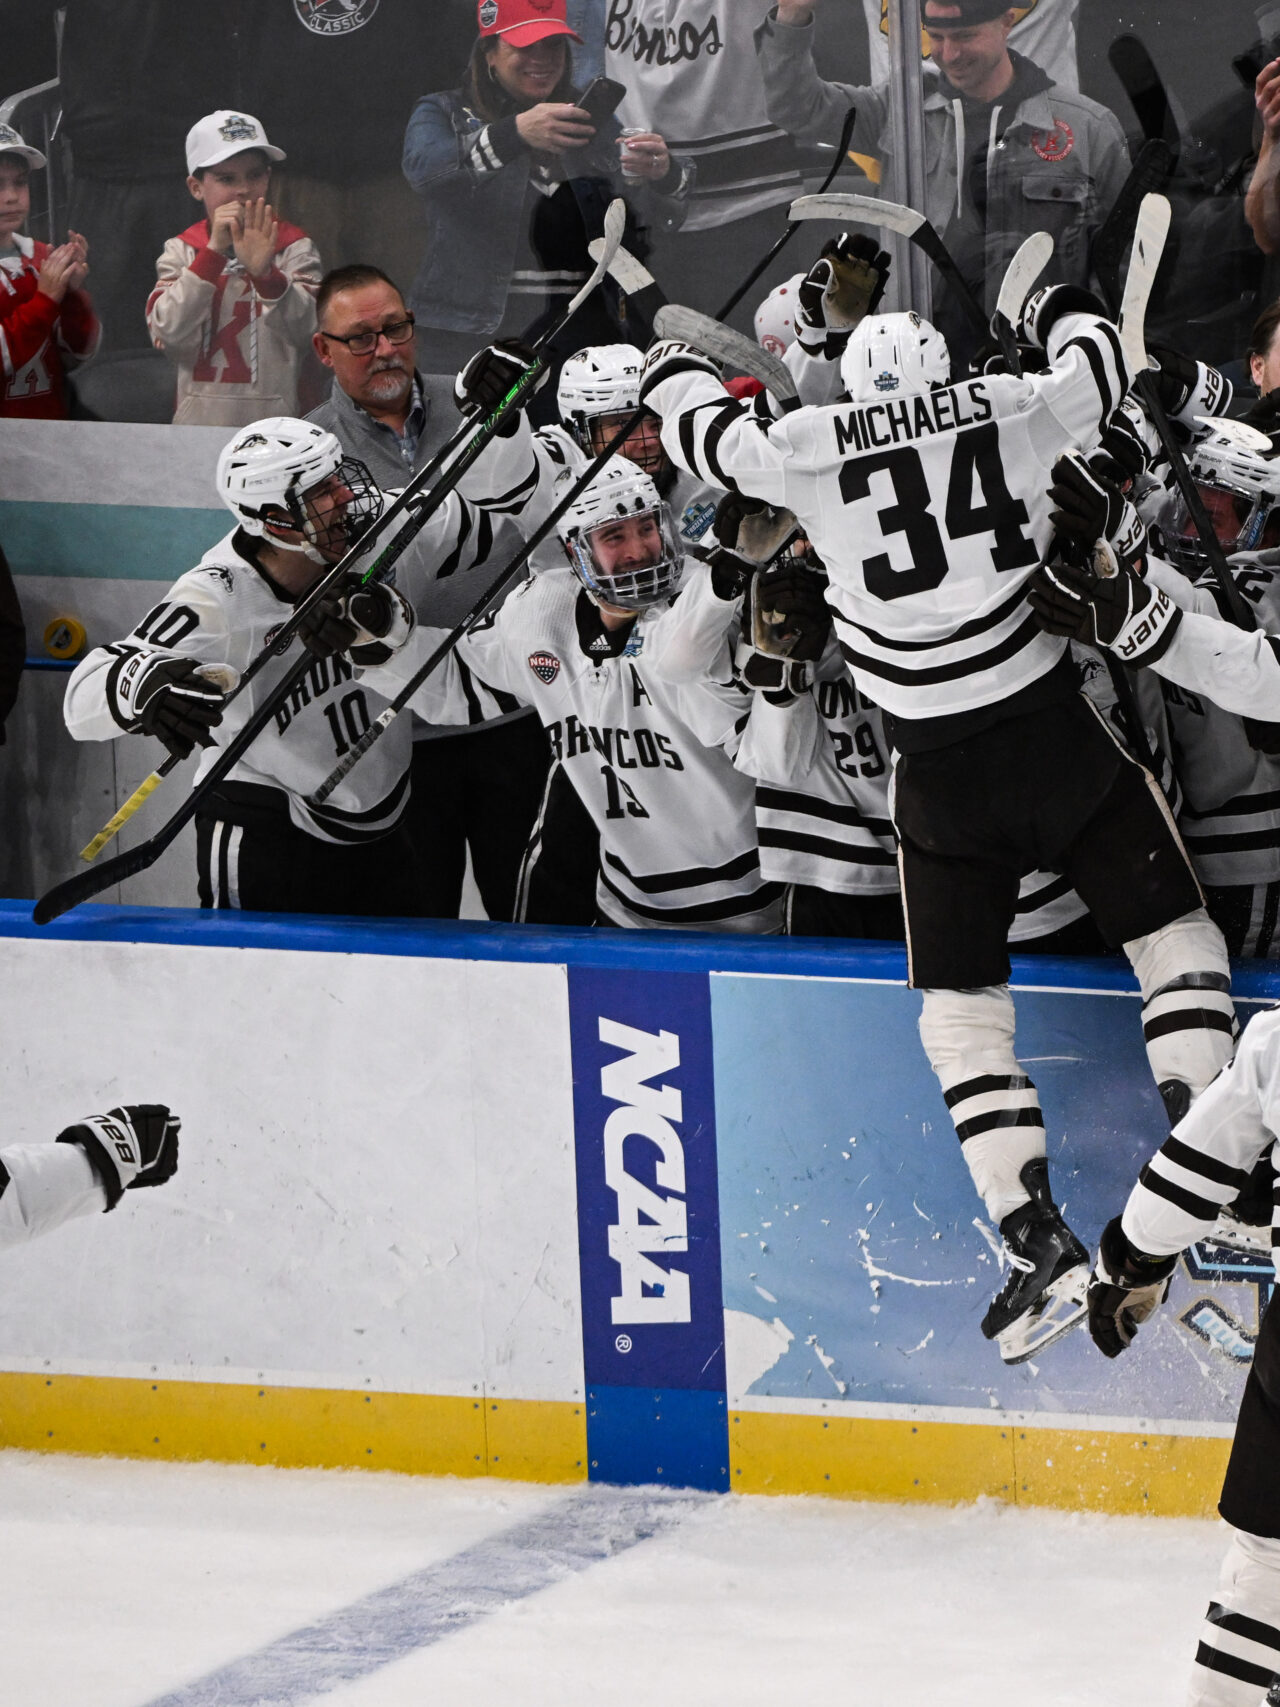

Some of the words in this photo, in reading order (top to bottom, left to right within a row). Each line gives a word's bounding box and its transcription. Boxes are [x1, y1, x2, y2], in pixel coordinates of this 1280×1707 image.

[309, 11, 365, 33] CLASSIC
[192, 270, 263, 383] K
[623, 366, 638, 375] 27
[833, 382, 992, 456] MICHAELS
[265, 518, 293, 528] BAUER
[838, 420, 1040, 602] 34
[1247, 510, 1265, 549] AUER
[133, 601, 200, 649] 10
[1118, 588, 1171, 658] AUER
[529, 656, 560, 669] NCHC
[628, 662, 653, 707] A
[323, 688, 372, 758] 10
[545, 713, 686, 772] BRNCOS
[828, 721, 885, 779] 29
[598, 1016, 692, 1325] NCAA
